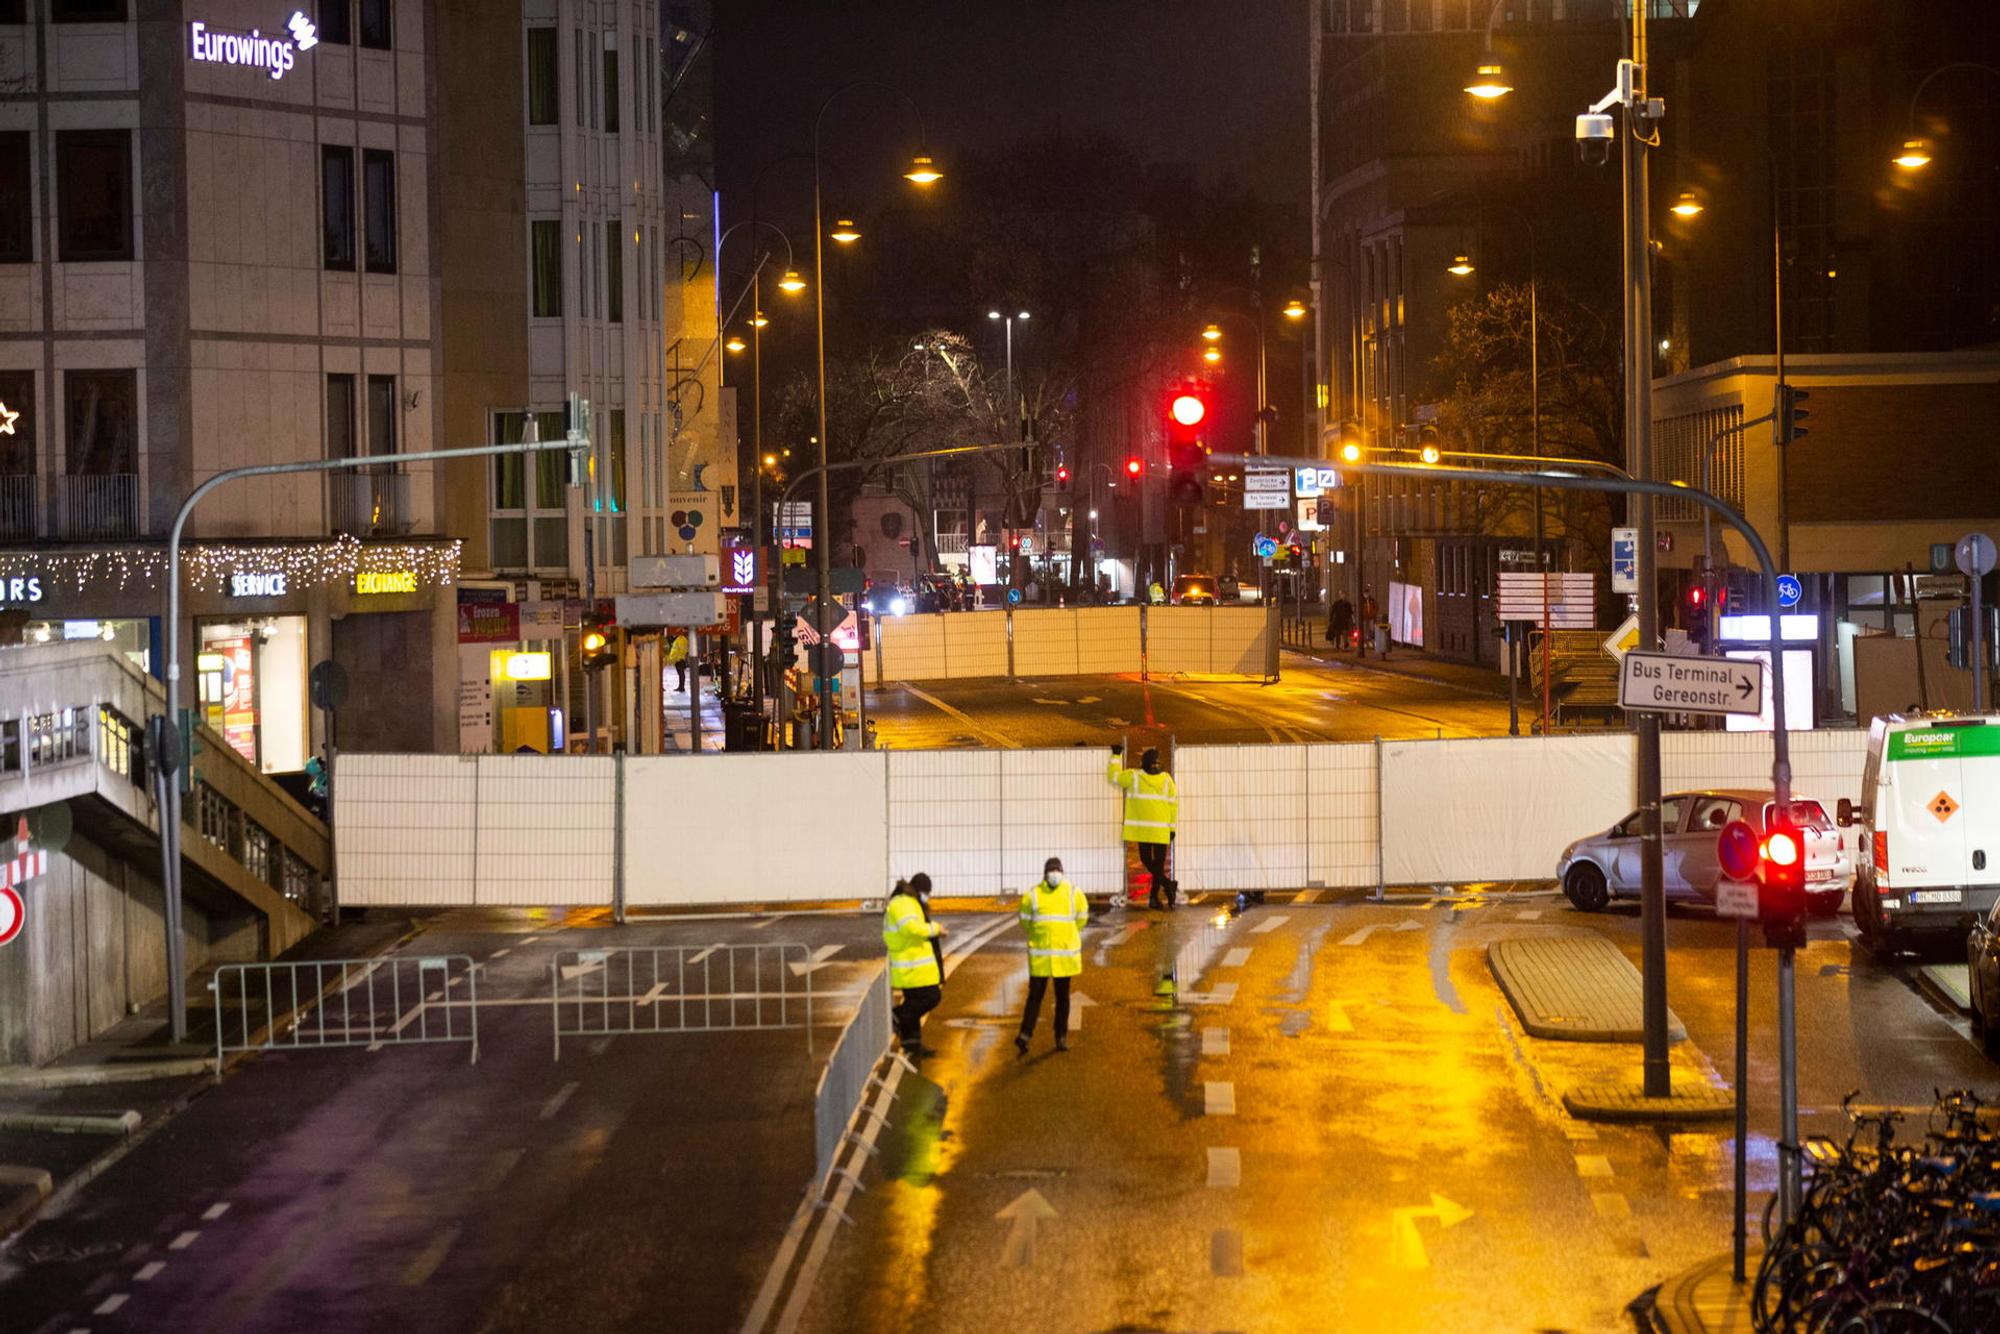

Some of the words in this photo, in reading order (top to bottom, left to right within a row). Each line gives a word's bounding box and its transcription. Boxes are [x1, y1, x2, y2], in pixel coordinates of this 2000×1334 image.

[192, 22, 294, 80] Eurowings
[231, 573, 287, 597] SERVICE
[473, 605, 500, 618] frozen
[1633, 661, 1661, 679] Bus
[1667, 664, 1733, 684] Terminal
[1653, 685, 1733, 706] Gereonstr.
[1904, 733, 1955, 745] Europcar
